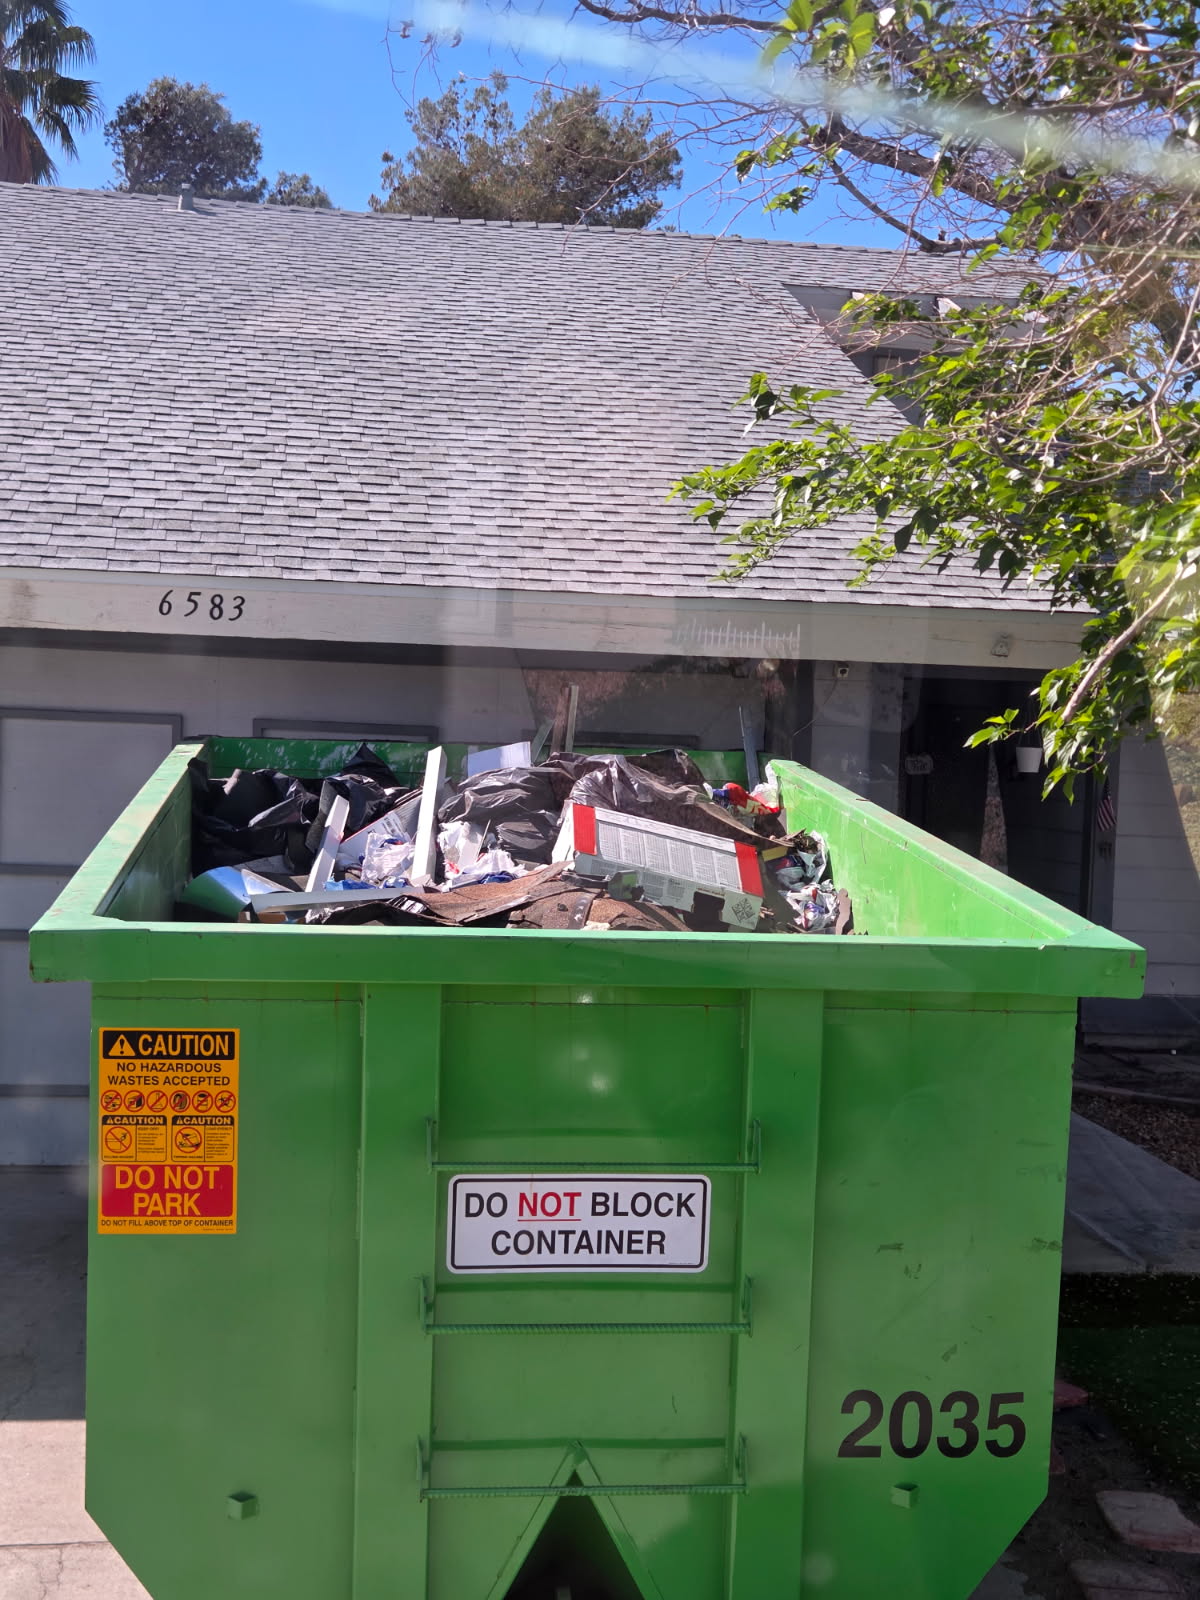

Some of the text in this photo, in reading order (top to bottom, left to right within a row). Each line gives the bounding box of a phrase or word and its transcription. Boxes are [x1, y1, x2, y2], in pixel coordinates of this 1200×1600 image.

[158, 589, 246, 622] 6583
[138, 1033, 229, 1057] CAUTION
[116, 1062, 222, 1073] NO HAZARDOUS
[107, 1075, 231, 1086] WASTES ACCEPTED
[114, 1116, 164, 1125] CAUTION
[183, 1116, 232, 1125] CAUTION
[115, 1166, 220, 1189] DO NOT
[133, 1193, 201, 1216] PARK
[463, 1192, 696, 1222] DO NOT BLOCK
[101, 1219, 234, 1227] DO NOT FILL ABOVE TOP OF CONTAINER
[491, 1230, 667, 1256] CONTAINER
[838, 1389, 1026, 1459] 2035
